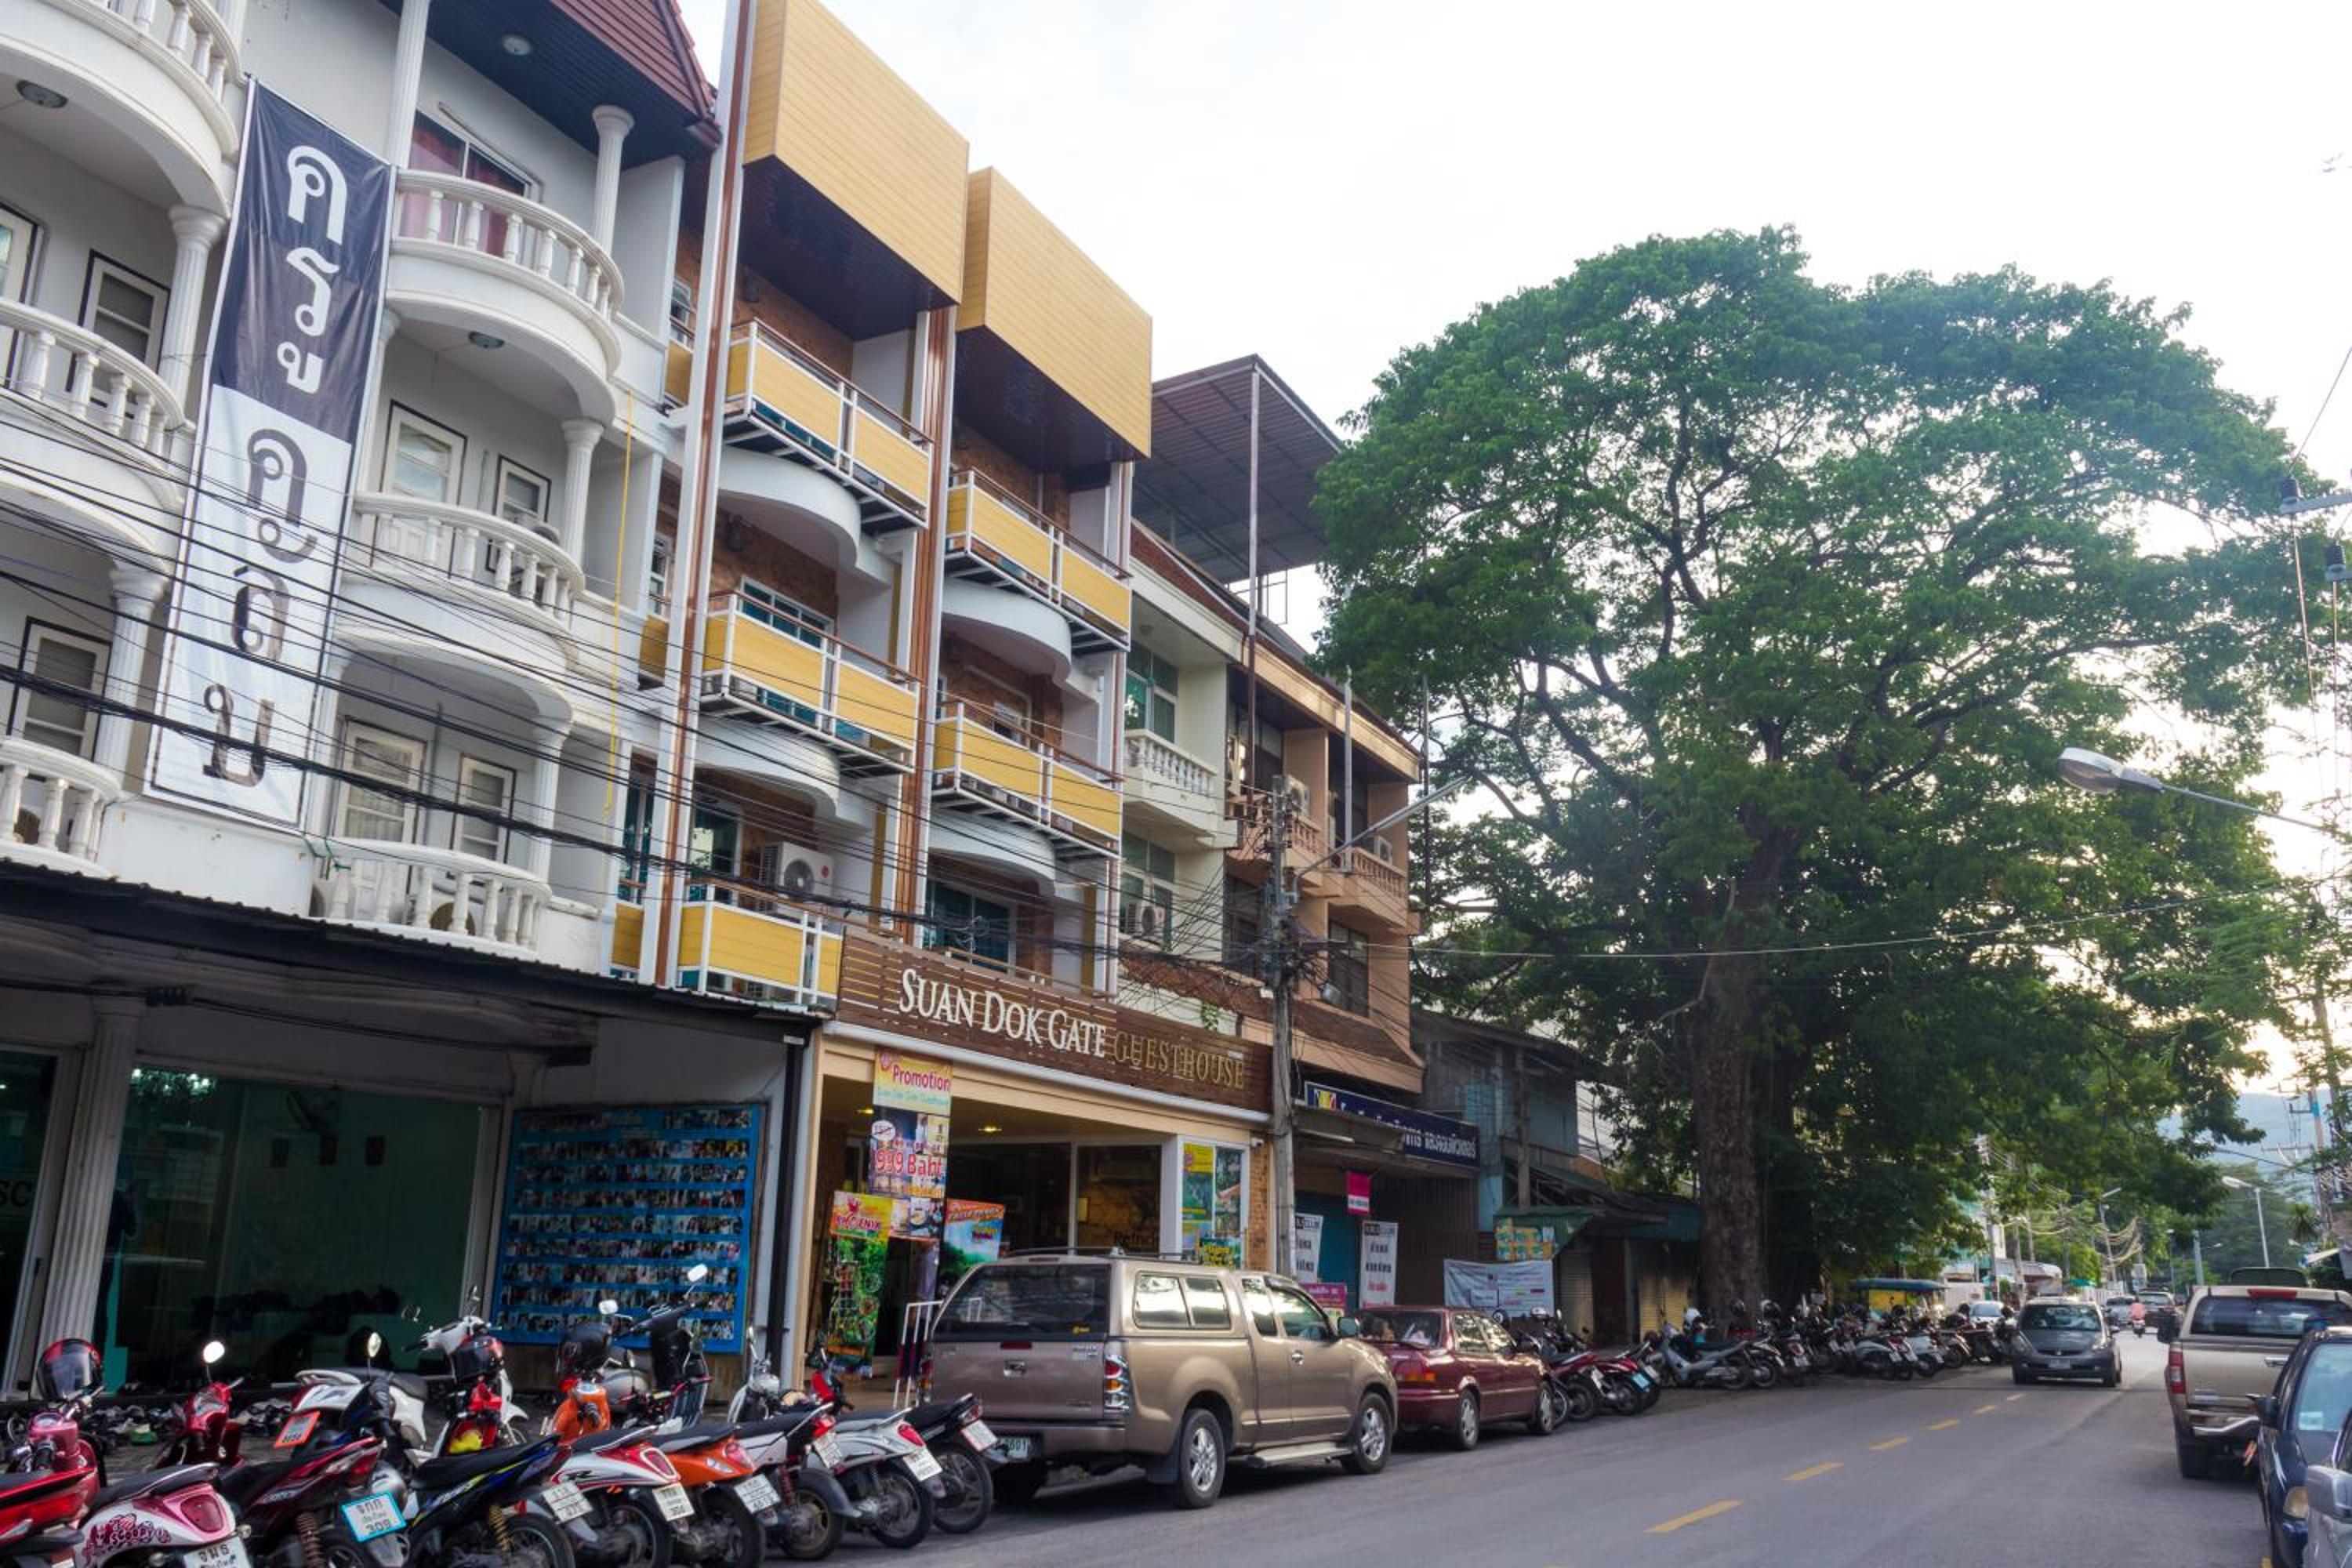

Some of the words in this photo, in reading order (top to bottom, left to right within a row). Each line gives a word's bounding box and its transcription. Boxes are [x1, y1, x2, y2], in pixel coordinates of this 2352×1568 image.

[899, 967, 977, 1028] SUAN
[982, 990, 1043, 1045] DOK
[1047, 1009, 1106, 1058] GATE
[1113, 1031, 1245, 1090] GUESTHOUSE
[892, 1063, 951, 1092] Promotion
[907, 1152, 942, 1178] Baht
